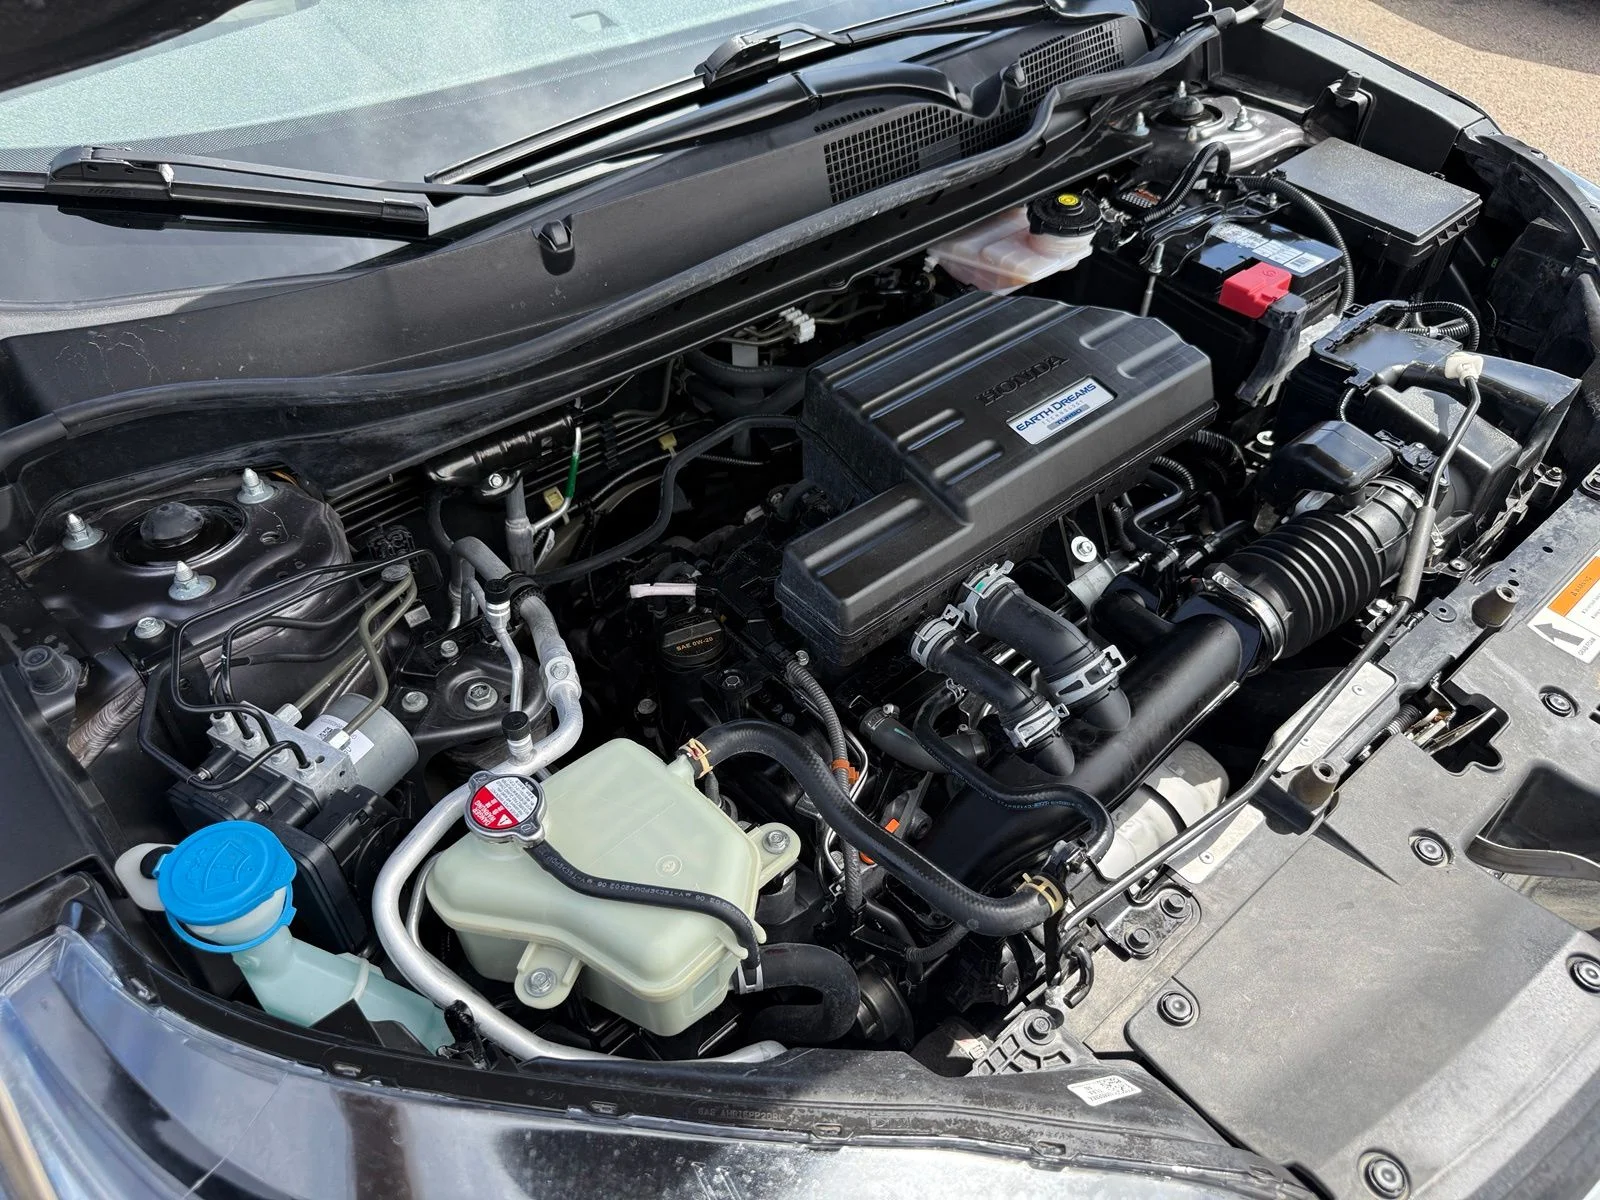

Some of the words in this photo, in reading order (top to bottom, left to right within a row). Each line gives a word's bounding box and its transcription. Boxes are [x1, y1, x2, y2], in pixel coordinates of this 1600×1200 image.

[974, 354, 1070, 406] HONDA
[1016, 407, 1052, 432] EARTH
[1051, 383, 1097, 411] DREAMS
[676, 642, 692, 651] SAE
[692, 636, 714, 646] 0W-20
[472, 807, 491, 827] DANGER
[475, 799, 497, 823] WARNING
